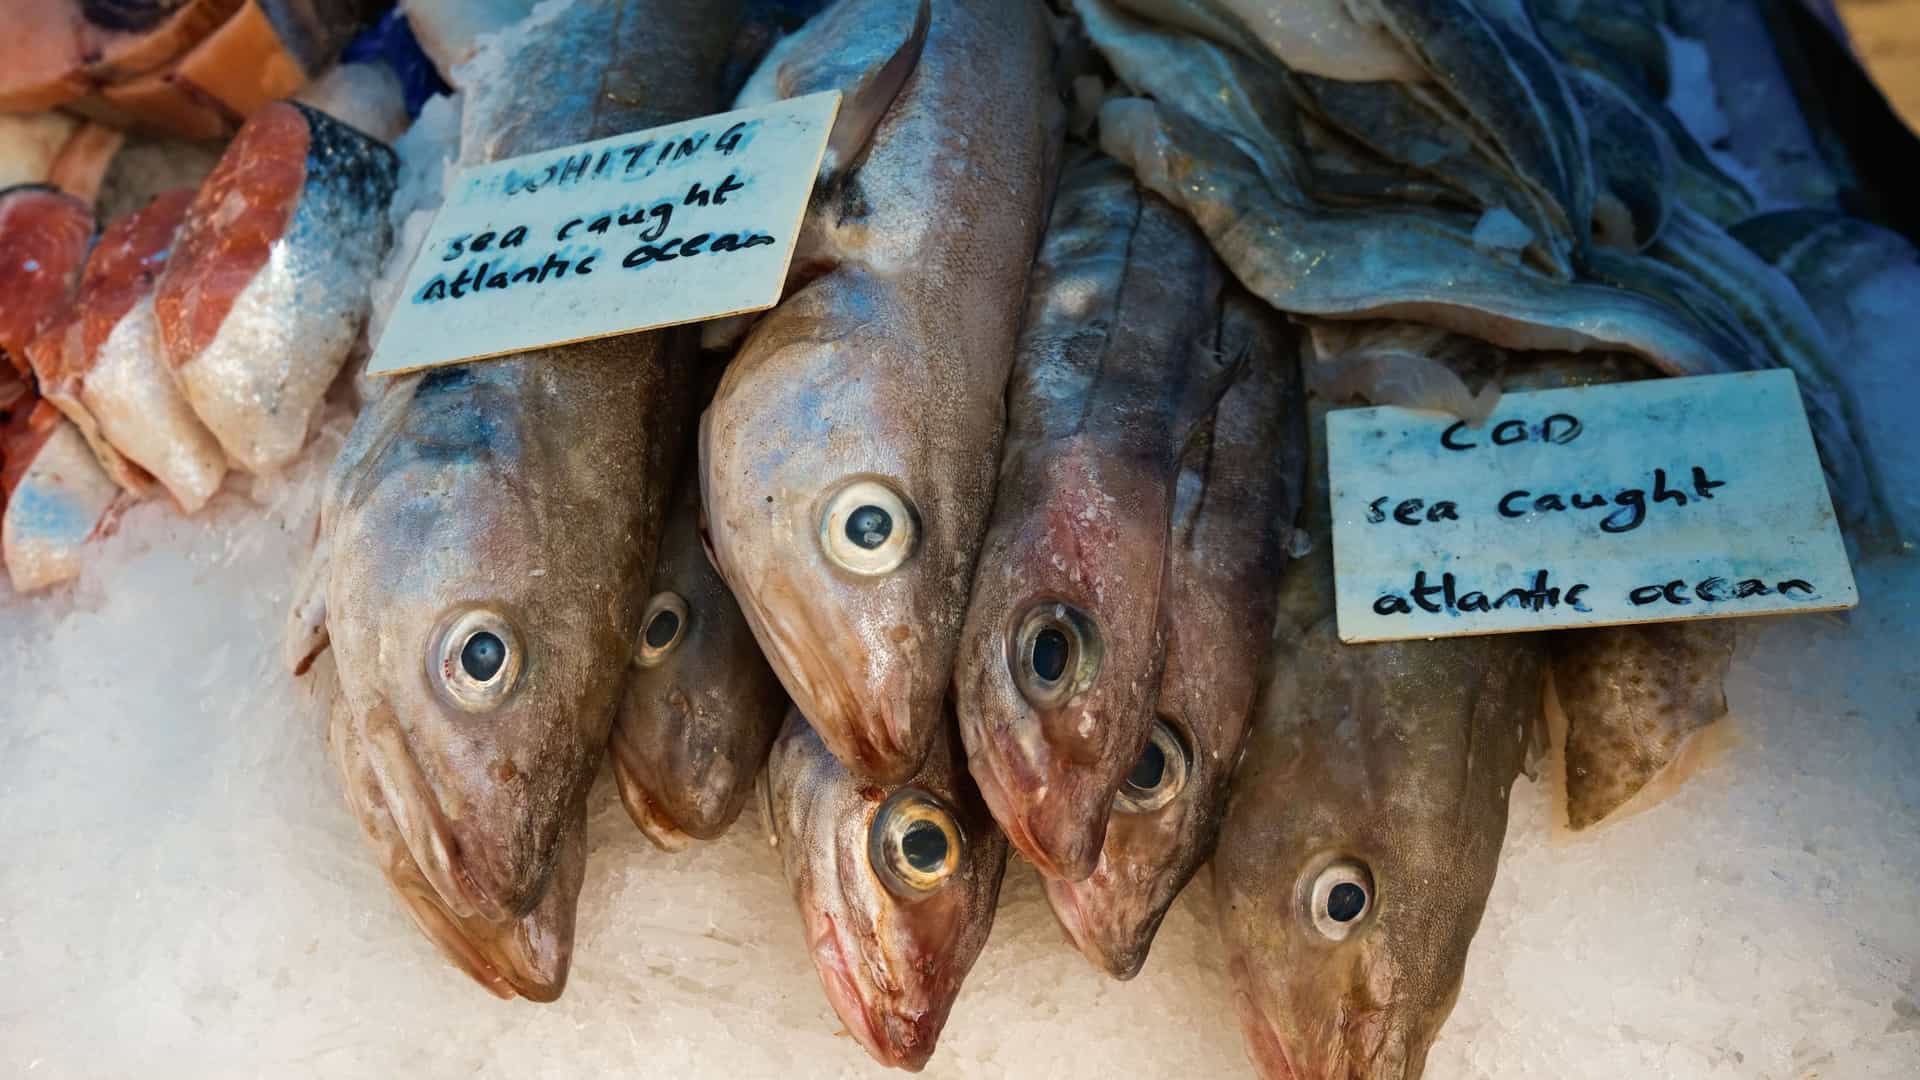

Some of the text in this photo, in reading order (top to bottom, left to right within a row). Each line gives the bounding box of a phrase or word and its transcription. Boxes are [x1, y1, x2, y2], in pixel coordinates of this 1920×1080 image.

[443, 174, 745, 261] sea caught
[622, 233, 776, 268] ocean
[1441, 413, 1584, 451] COD
[1367, 467, 1725, 533] sea caught
[1373, 569, 1817, 615] atlantic ocean
